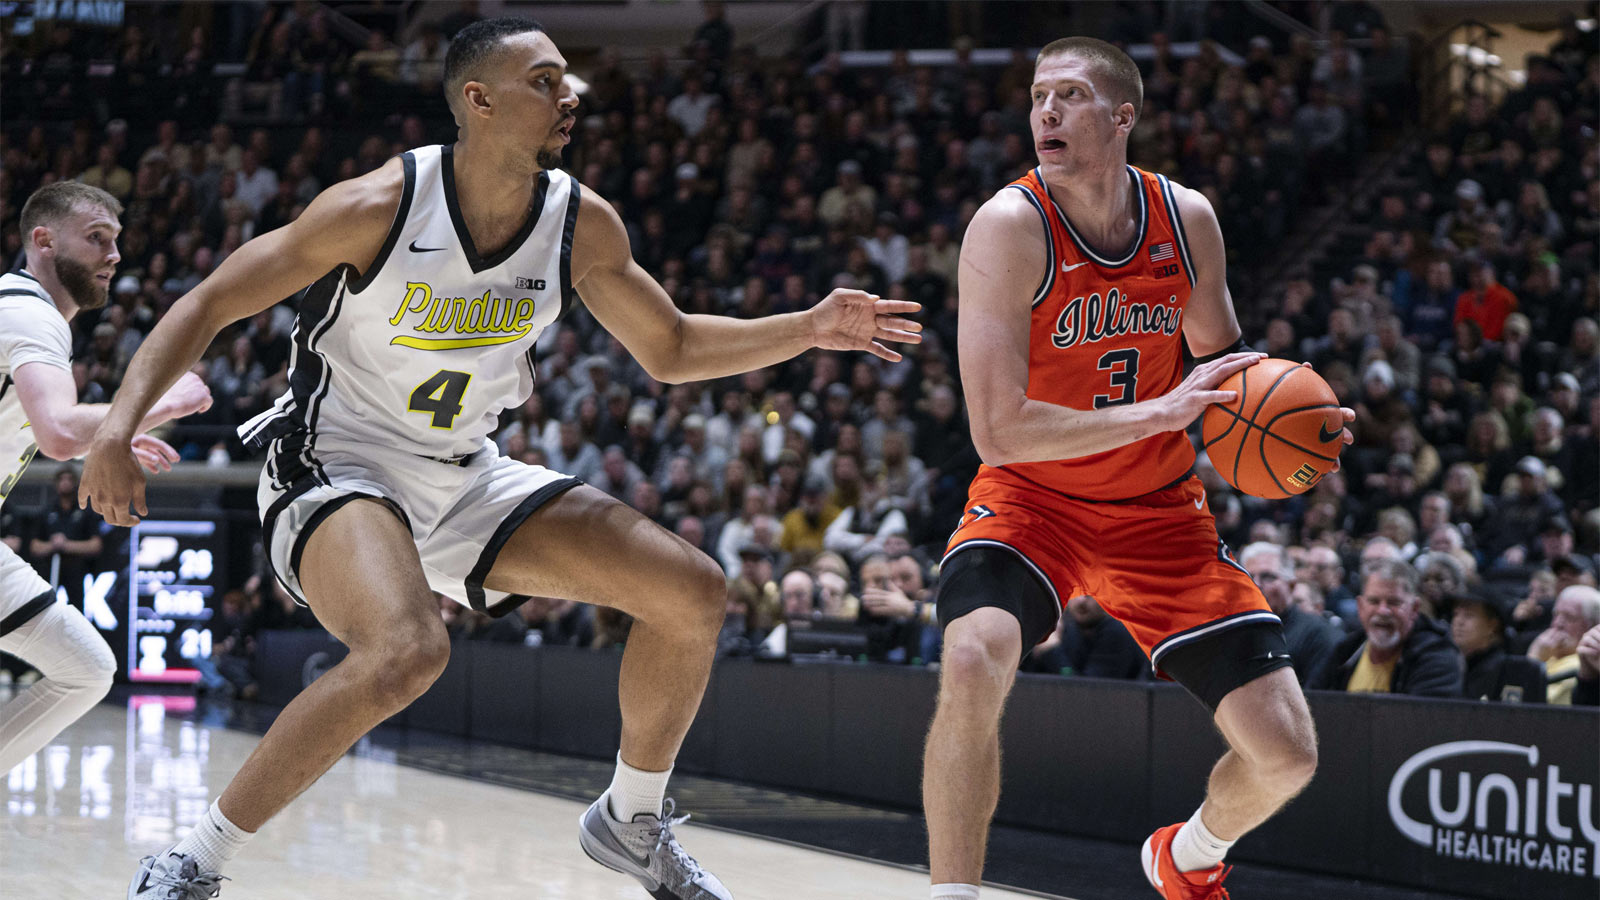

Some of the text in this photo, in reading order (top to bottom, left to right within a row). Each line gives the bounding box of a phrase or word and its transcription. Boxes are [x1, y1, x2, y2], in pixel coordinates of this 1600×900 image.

[389, 281, 535, 334] Purdue
[1052, 288, 1182, 349] Illinois
[407, 368, 473, 430] 4
[1093, 347, 1140, 410] 3
[180, 628, 213, 659] 21
[1436, 828, 1587, 876] HEALTHCARE
